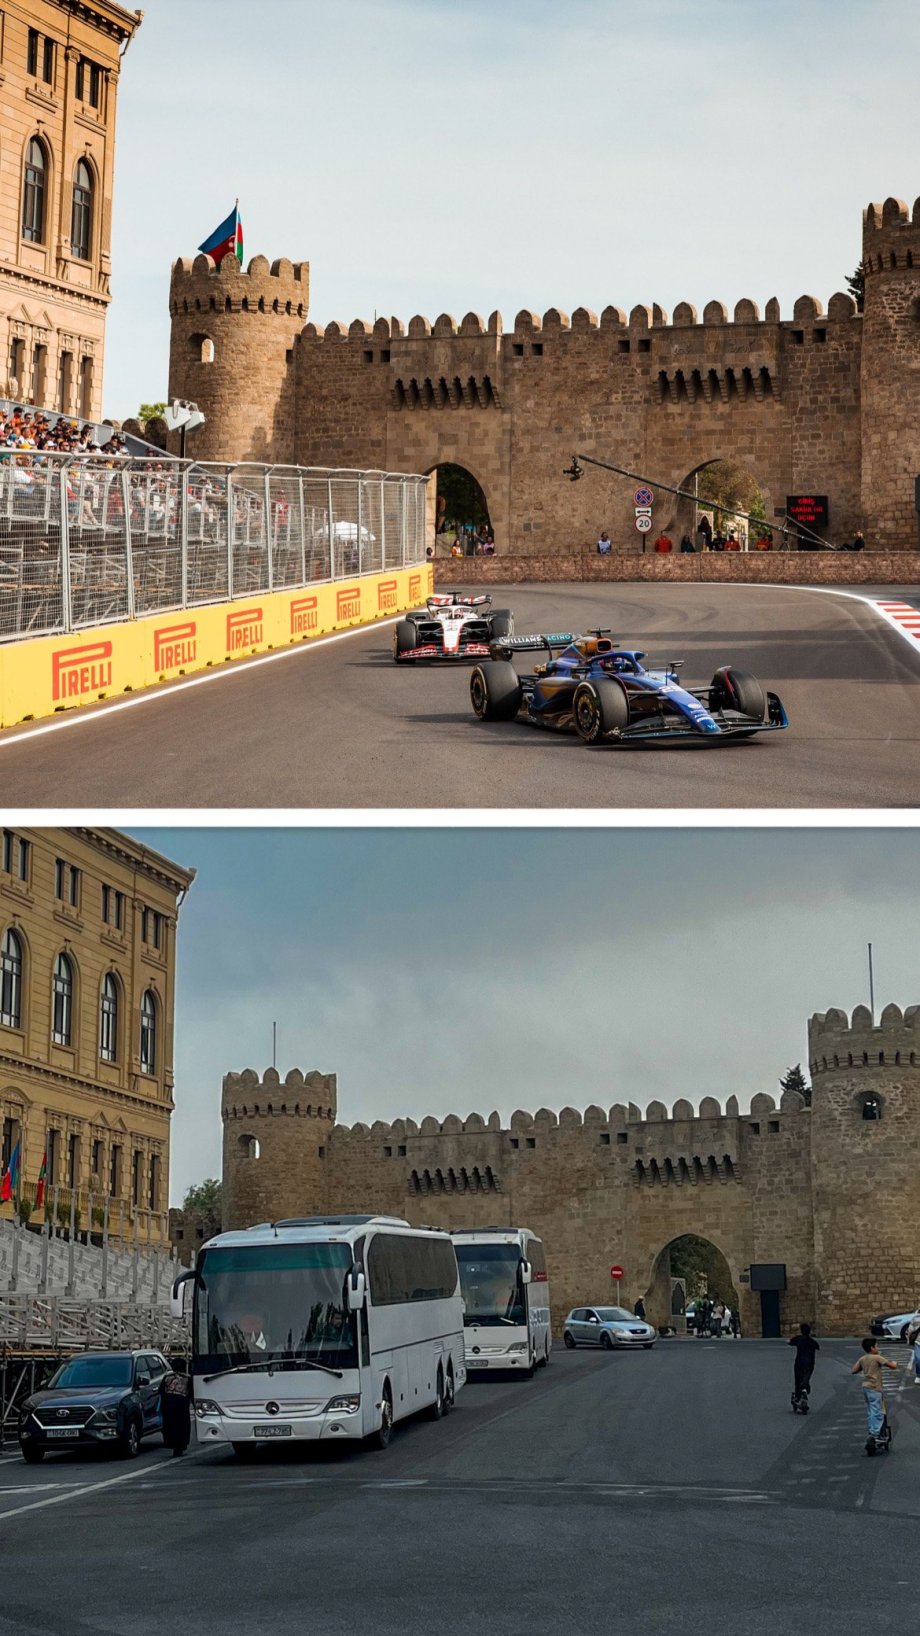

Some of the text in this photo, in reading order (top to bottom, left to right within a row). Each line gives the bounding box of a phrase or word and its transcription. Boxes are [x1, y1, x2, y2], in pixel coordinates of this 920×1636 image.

[639, 519, 650, 528] 20
[337, 588, 361, 621] PIRELLI
[378, 580, 397, 610] PIRELLI
[227, 608, 262, 651] PIRELLI
[291, 597, 318, 634] PIRELLI
[154, 622, 196, 672] PIRELLI
[503, 634, 571, 644] WILLIAMS ACING
[52, 640, 112, 700] PIRELLI
